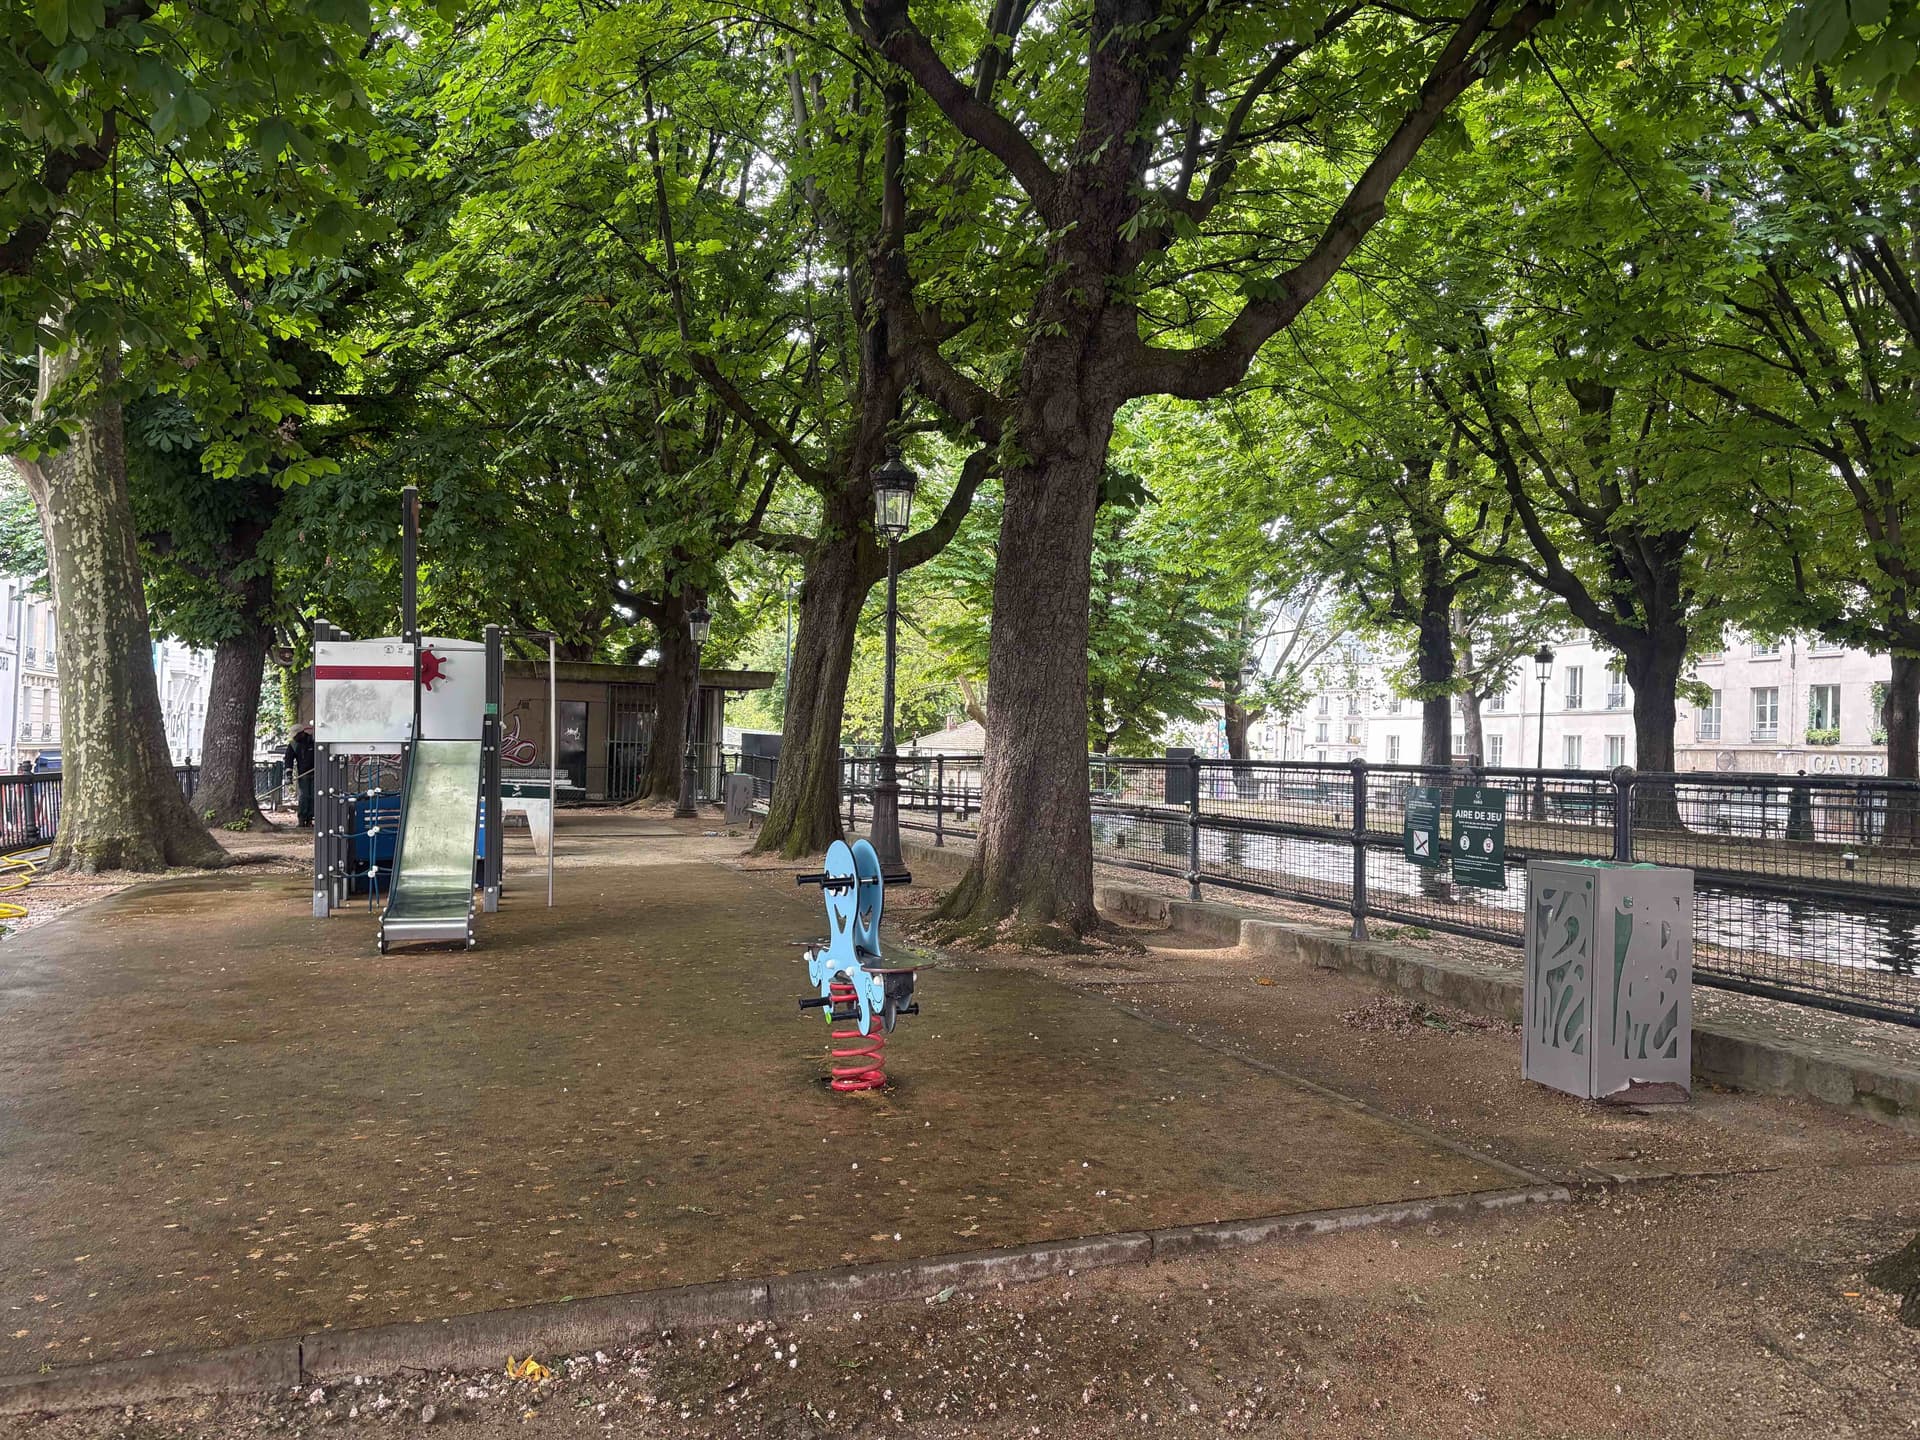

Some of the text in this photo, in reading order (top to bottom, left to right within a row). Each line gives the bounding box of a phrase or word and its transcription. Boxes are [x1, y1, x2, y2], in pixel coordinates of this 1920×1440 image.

[1455, 809, 1502, 822] AIRE DE JEU
